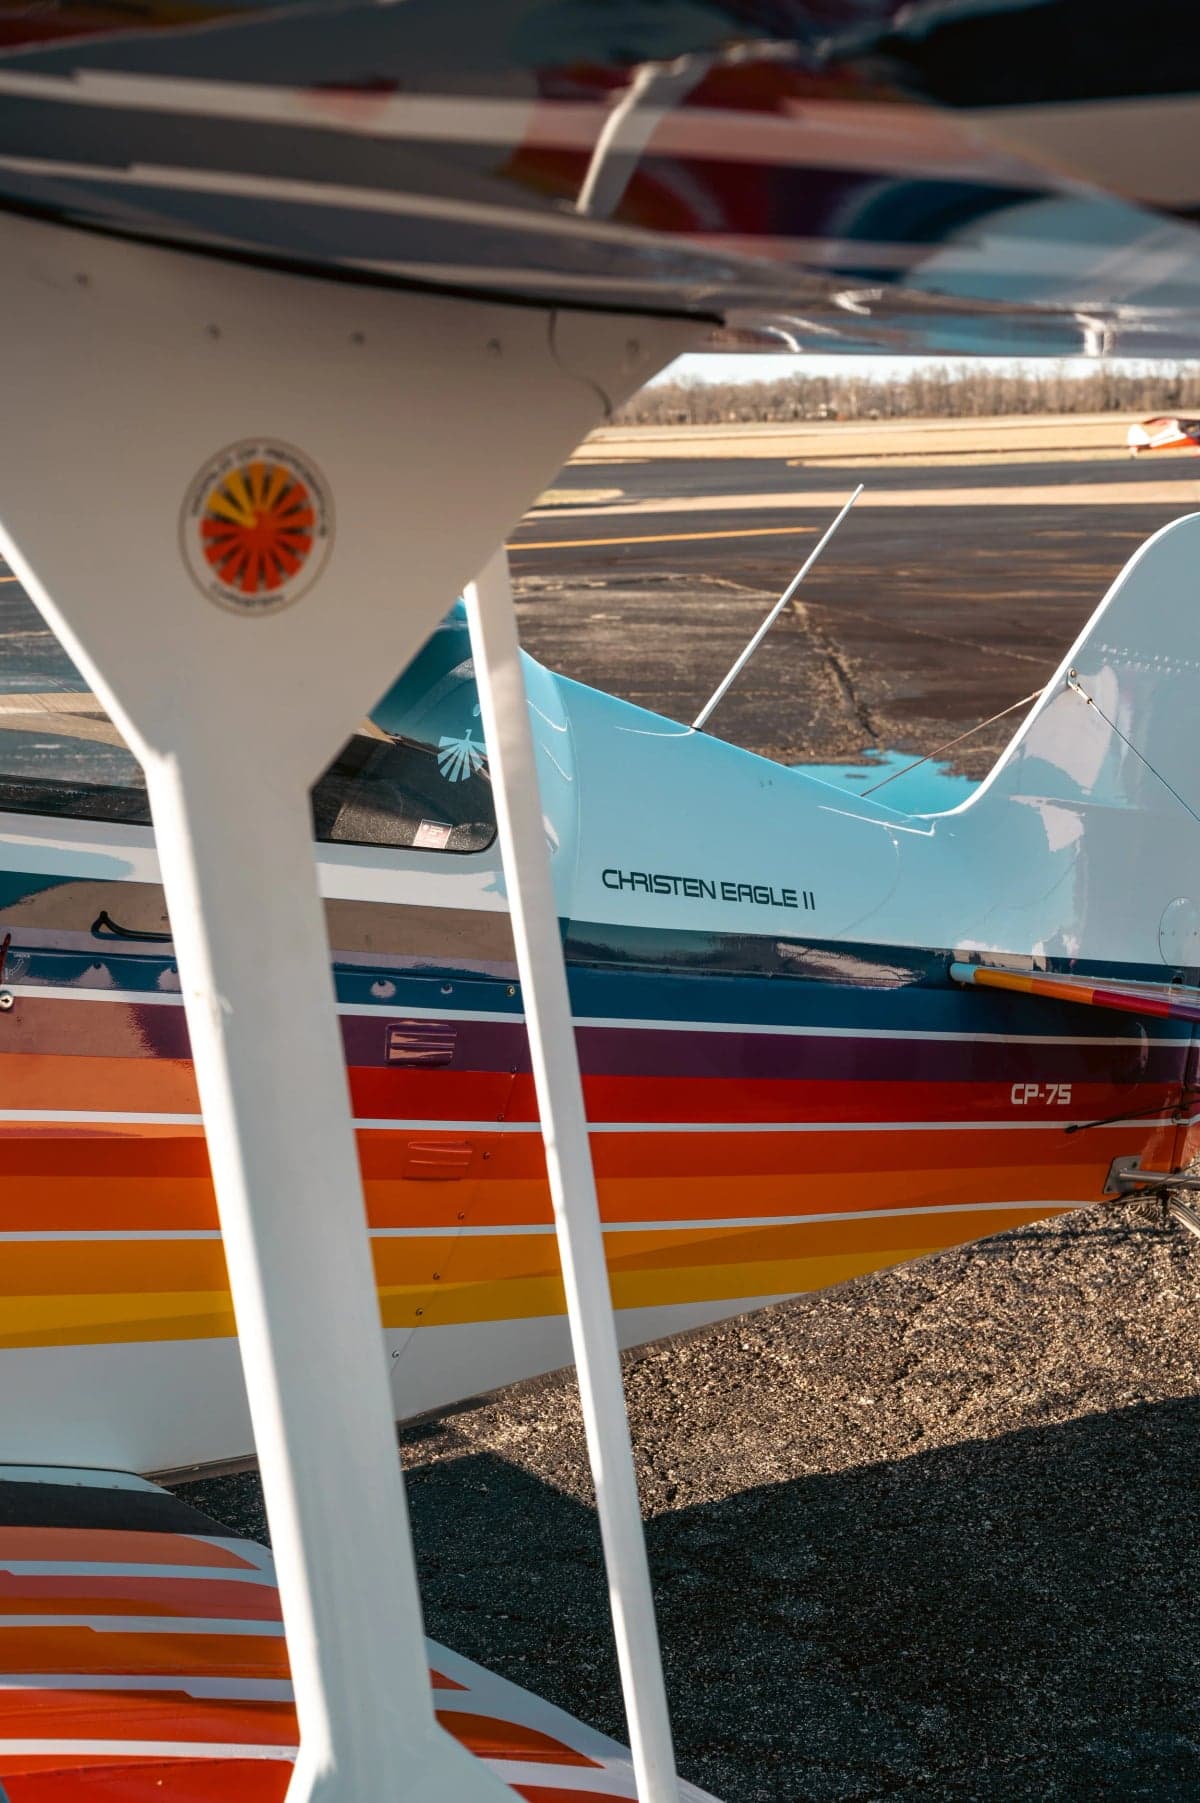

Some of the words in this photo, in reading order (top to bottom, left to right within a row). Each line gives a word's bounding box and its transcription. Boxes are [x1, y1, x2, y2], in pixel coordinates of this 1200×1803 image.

[602, 869, 717, 900] CHRISTEN
[720, 881, 799, 908] EAGLE
[803, 890, 816, 911] II
[1011, 1083, 1072, 1105] CP-75
